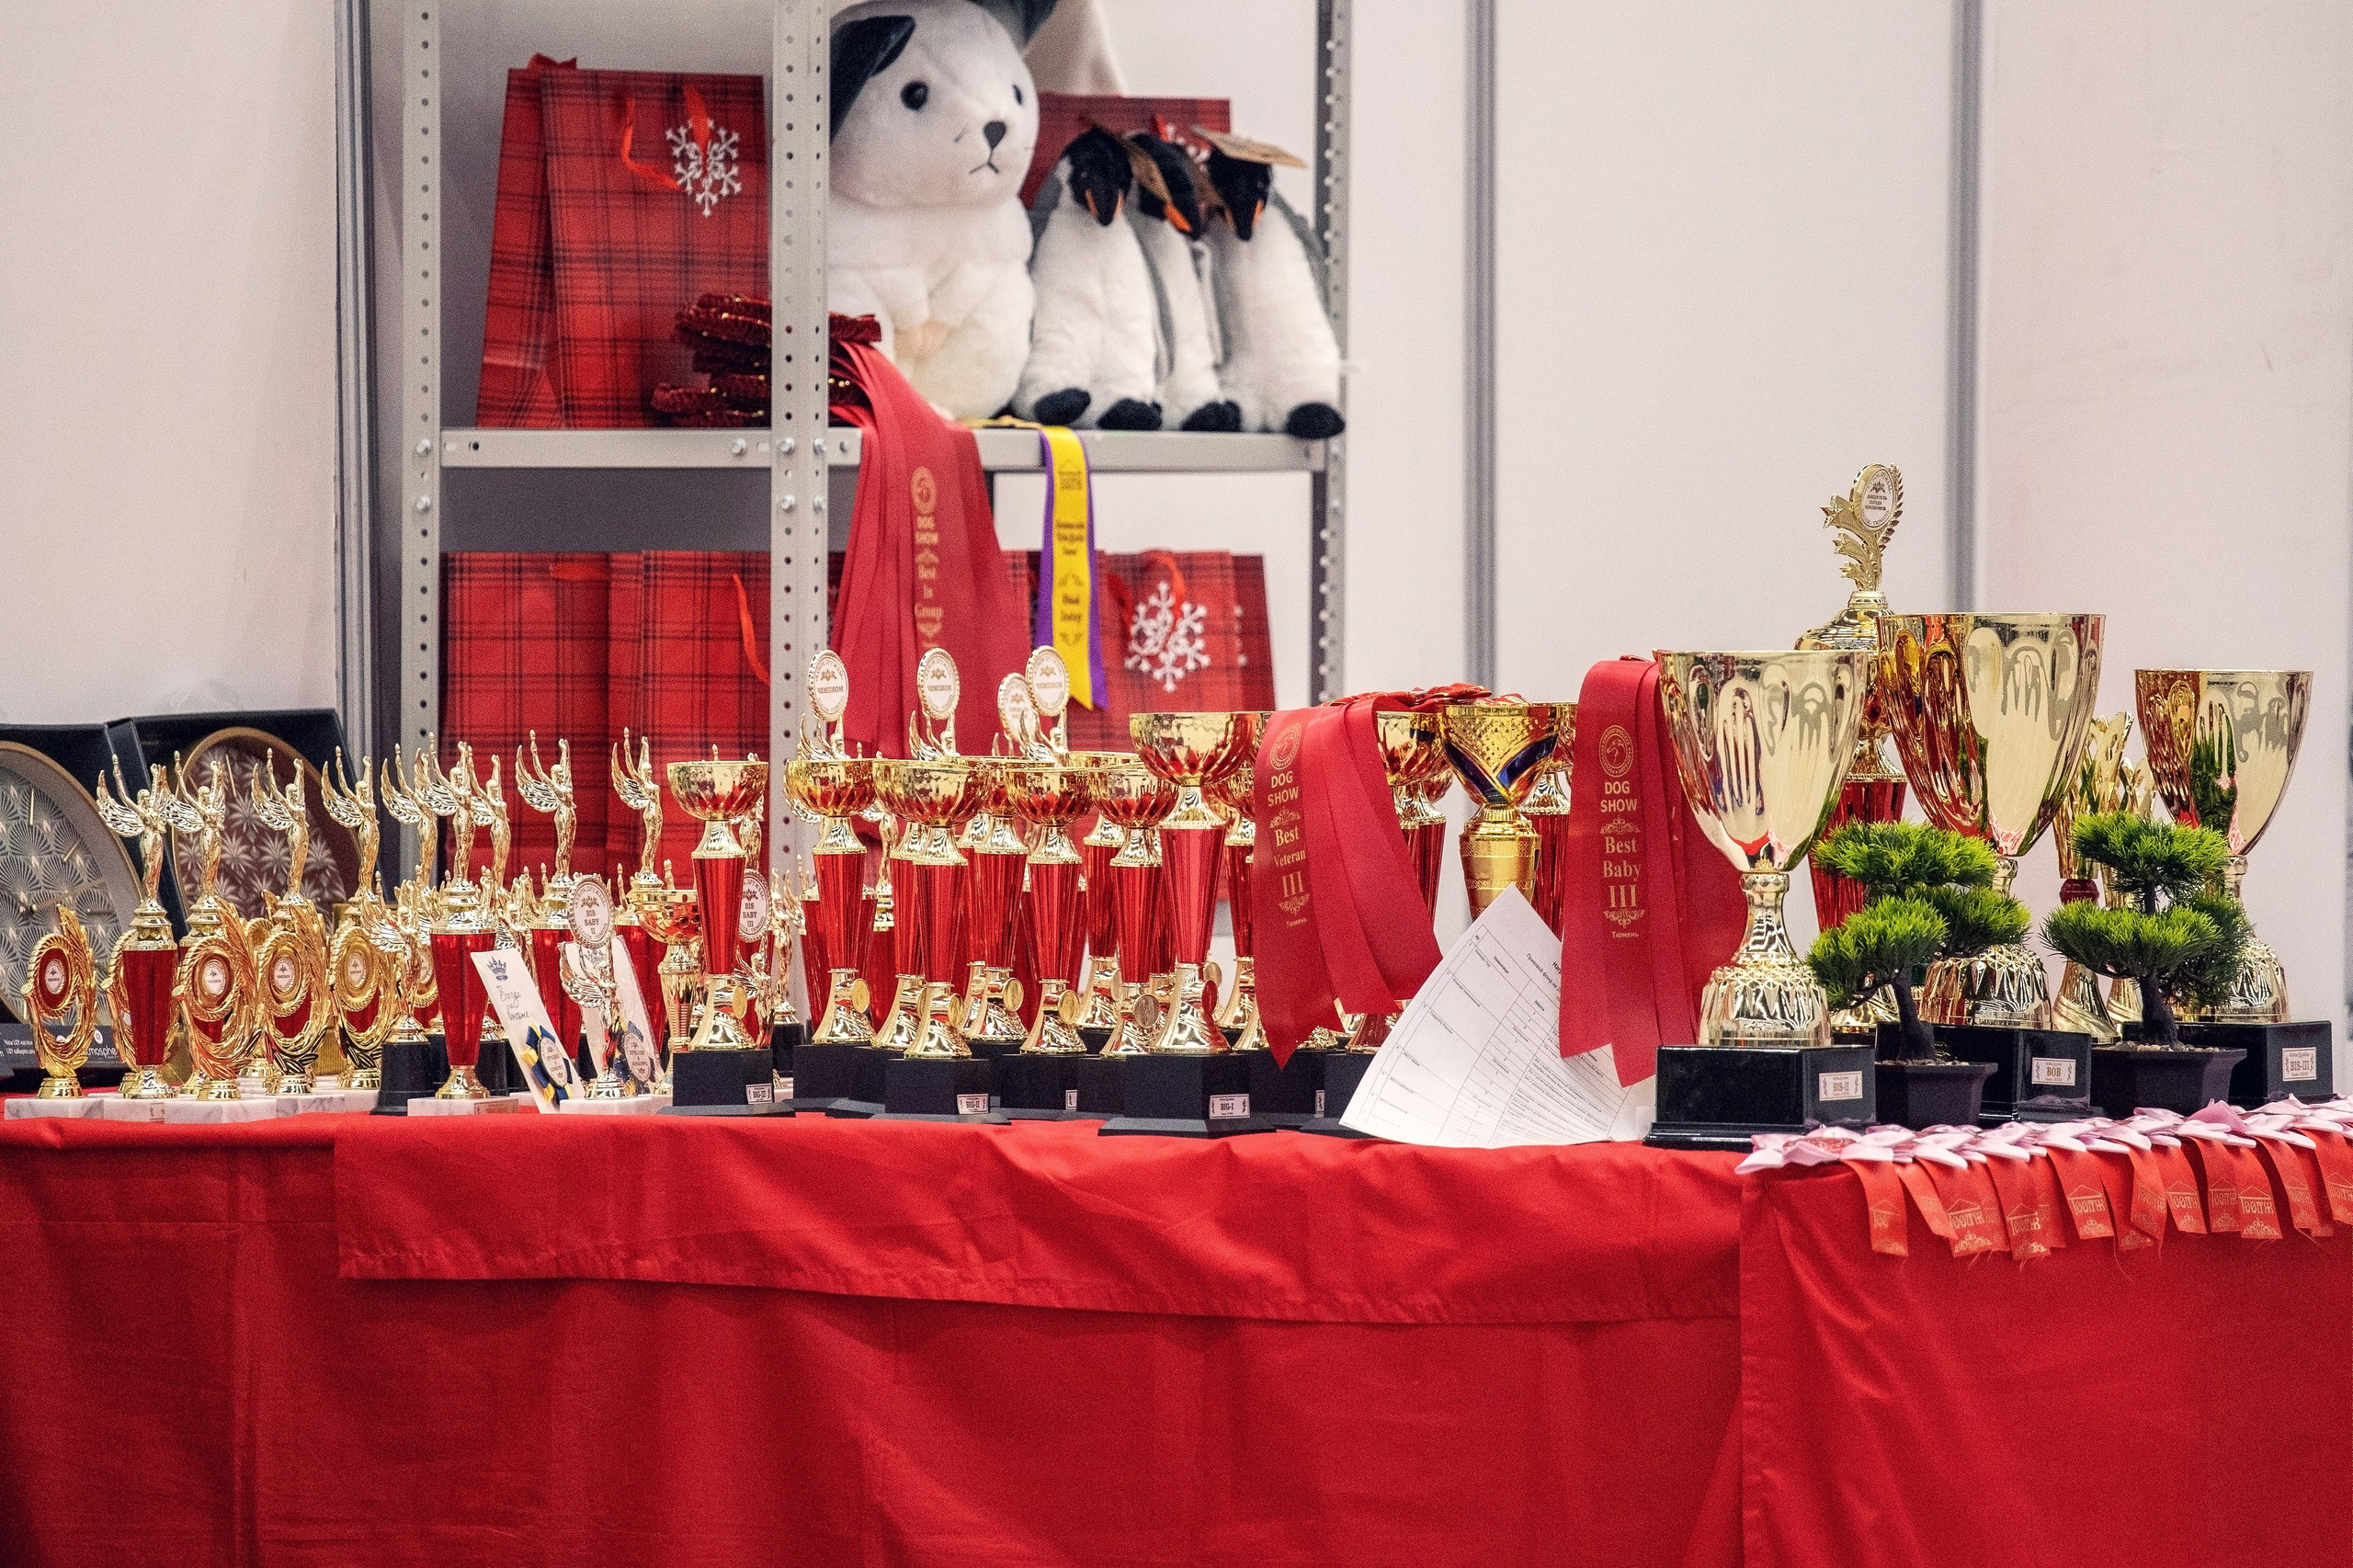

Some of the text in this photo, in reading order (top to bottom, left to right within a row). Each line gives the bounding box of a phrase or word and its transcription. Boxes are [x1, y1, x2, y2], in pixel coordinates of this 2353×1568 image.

[817, 686, 844, 694] ЧЕМПИОН
[1270, 770, 1293, 789] DOG
[1605, 781, 1630, 794] DOG
[1267, 787, 1299, 807] SHOW
[1600, 799, 1637, 812] SHOW
[1275, 825, 1300, 847] Best
[1605, 837, 1637, 854] Best
[1273, 848, 1306, 868] Veteran
[1603, 860, 1642, 881] Baby
[1281, 871, 1303, 898] III
[1608, 884, 1637, 908] III
[1611, 931, 1640, 939] Тюмень
[1525, 952, 1545, 973] Призовой
[1540, 970, 1554, 983] фонд
[2047, 1067, 2062, 1076] BOB
[2290, 1061, 2310, 1071] BIS-III
[1833, 1082, 1849, 1092] BIS-II
